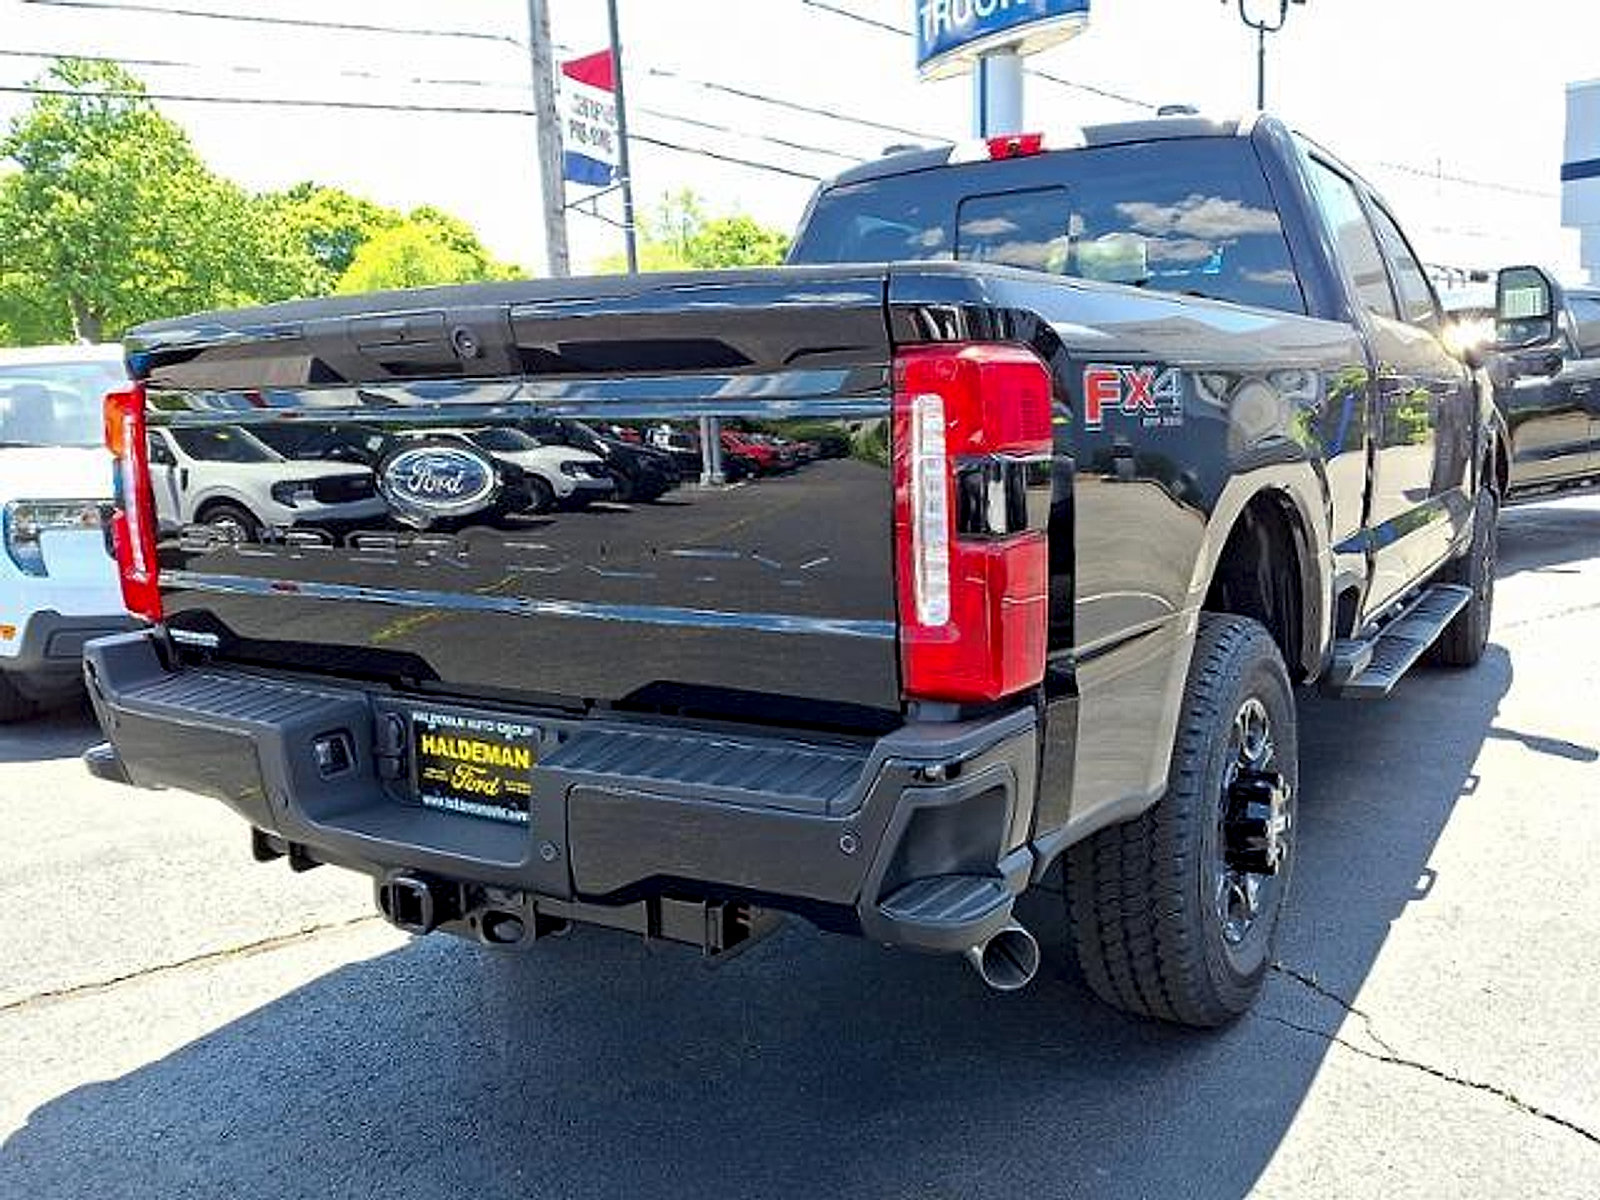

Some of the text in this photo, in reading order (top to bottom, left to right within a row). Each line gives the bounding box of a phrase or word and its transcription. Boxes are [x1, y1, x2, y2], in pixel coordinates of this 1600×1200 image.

[1083, 363, 1181, 431] FX4
[421, 734, 530, 769] HALDEMAN
[450, 763, 500, 797] Ford
